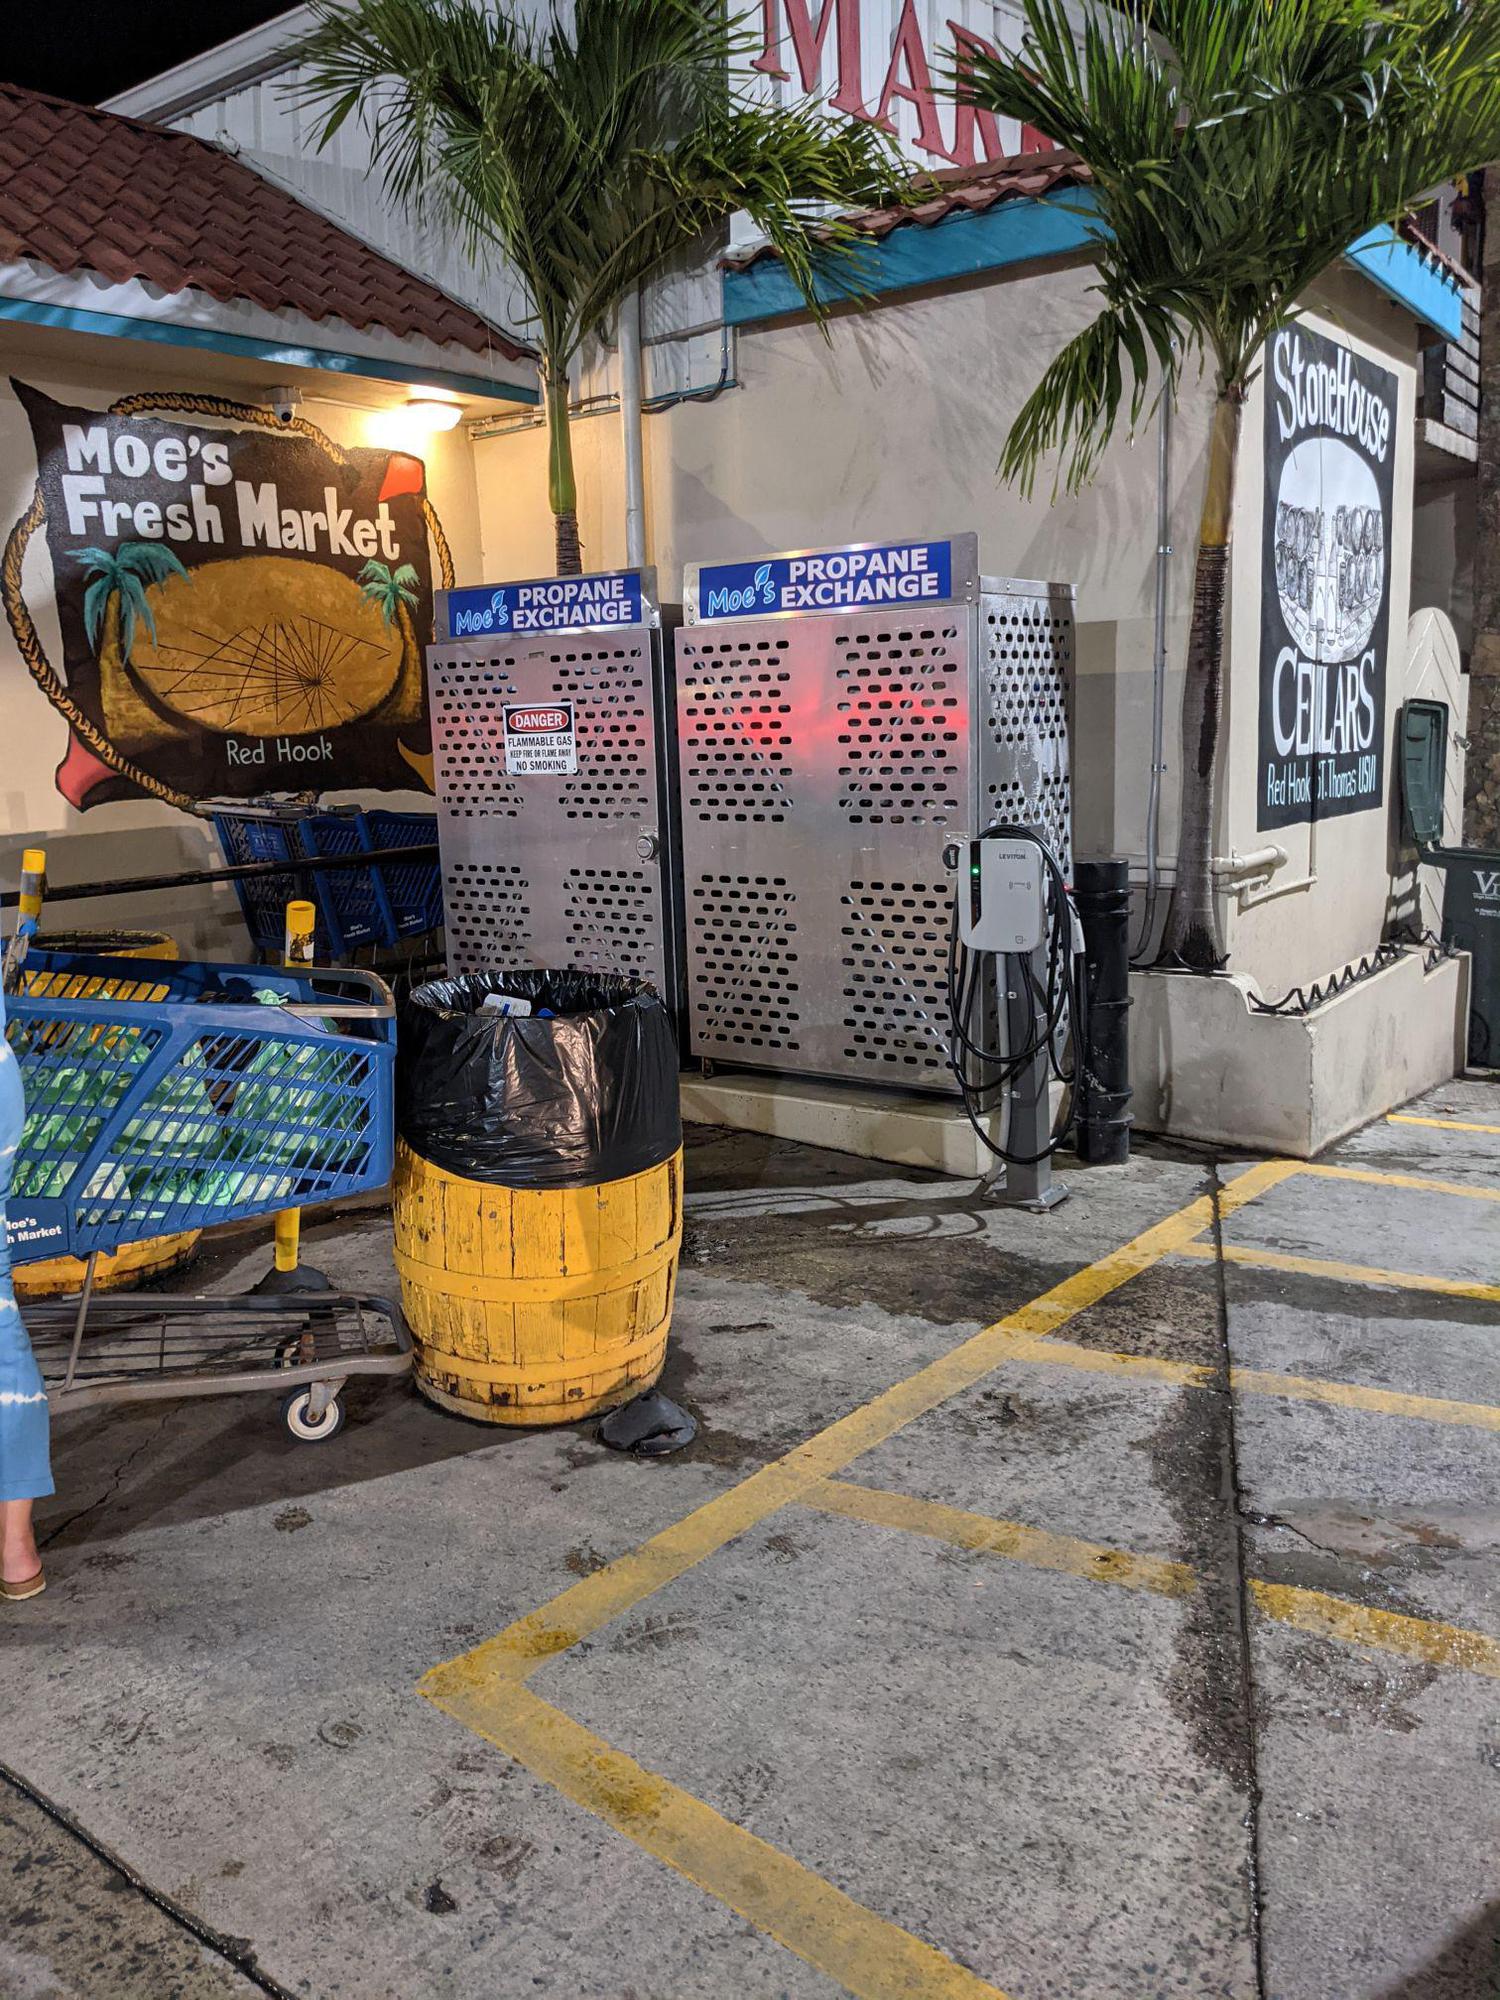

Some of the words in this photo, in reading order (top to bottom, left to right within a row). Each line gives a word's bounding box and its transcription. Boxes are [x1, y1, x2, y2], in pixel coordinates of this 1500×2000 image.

[751, 0, 1055, 167] MAR
[62, 424, 234, 486] Moe's
[62, 475, 225, 543] Fresh
[235, 481, 400, 560] Market
[789, 547, 929, 583] PROPANE
[519, 578, 625, 607] PROPANE
[708, 564, 776, 616] Moe's
[781, 572, 938, 608] EXCHANGE
[455, 590, 508, 635] Moe's
[512, 600, 632, 629] EXCHANGE
[515, 712, 562, 728] DANGER
[226, 739, 265, 765] Red
[276, 737, 333, 764] Hook
[508, 736, 554, 747] FLAMMABLE
[557, 735, 572, 746] GAS
[510, 749, 522, 758] KEEP
[523, 749, 533, 758] FIRE
[535, 749, 541, 758] OR
[542, 749, 557, 758] FLAME
[558, 748, 571, 757] AWAY
[516, 760, 527, 771] NO
[530, 760, 567, 771] SMOKING
[1267, 763, 1286, 806] Red
[1288, 761, 1312, 805] Hook
[1327, 759, 1357, 798] Thomas
[1358, 754, 1377, 793] USVI
[18, 1225, 62, 1242] Market
